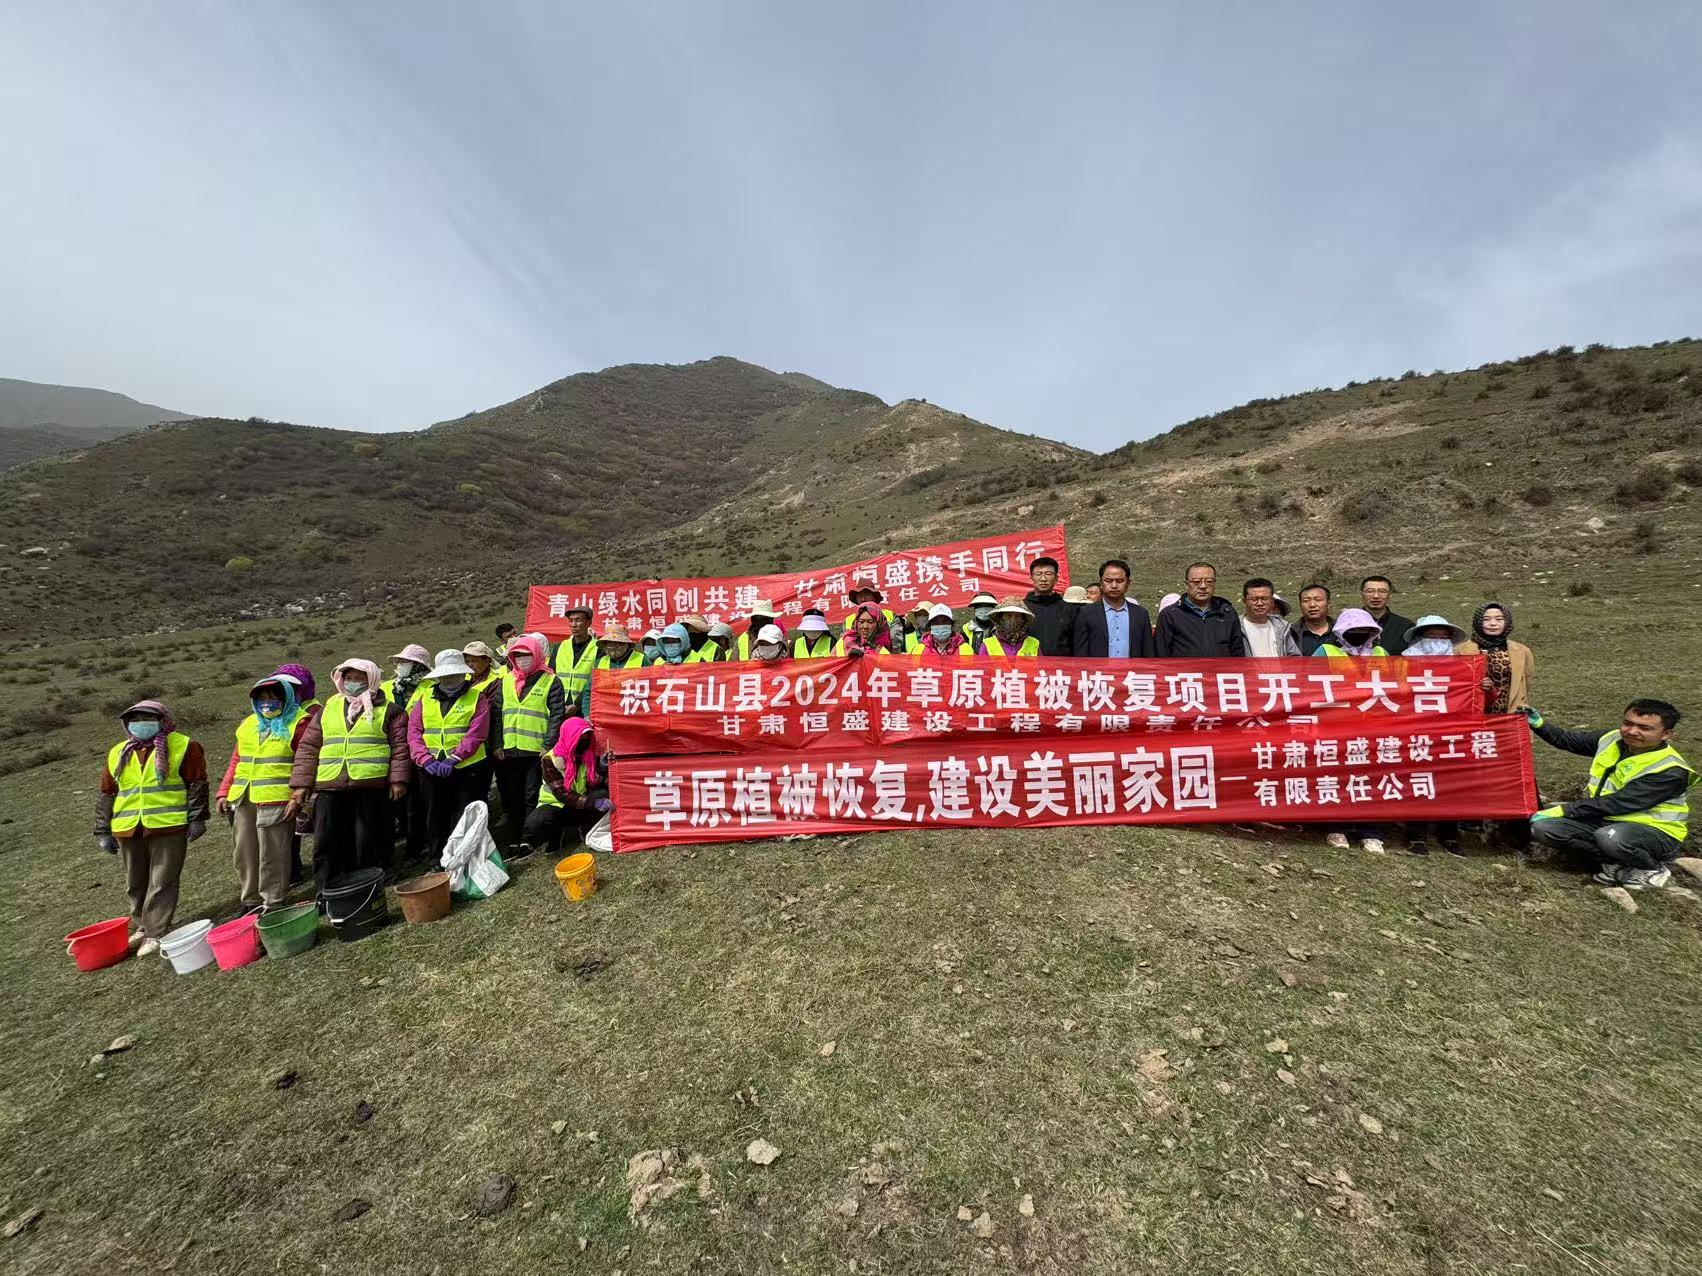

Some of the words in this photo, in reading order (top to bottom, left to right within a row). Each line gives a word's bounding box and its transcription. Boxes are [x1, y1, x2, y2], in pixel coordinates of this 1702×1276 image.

[794, 541, 1045, 599] 甘肃恒盛携手同行
[547, 584, 760, 619] 青山绿水同创共建
[619, 667, 1451, 716] 积石山县2024年草原植被恢复项目开工大吉
[1251, 730, 1499, 770] 甘肃恒盛建设工程
[1253, 772, 1437, 807] 有限责任公司
